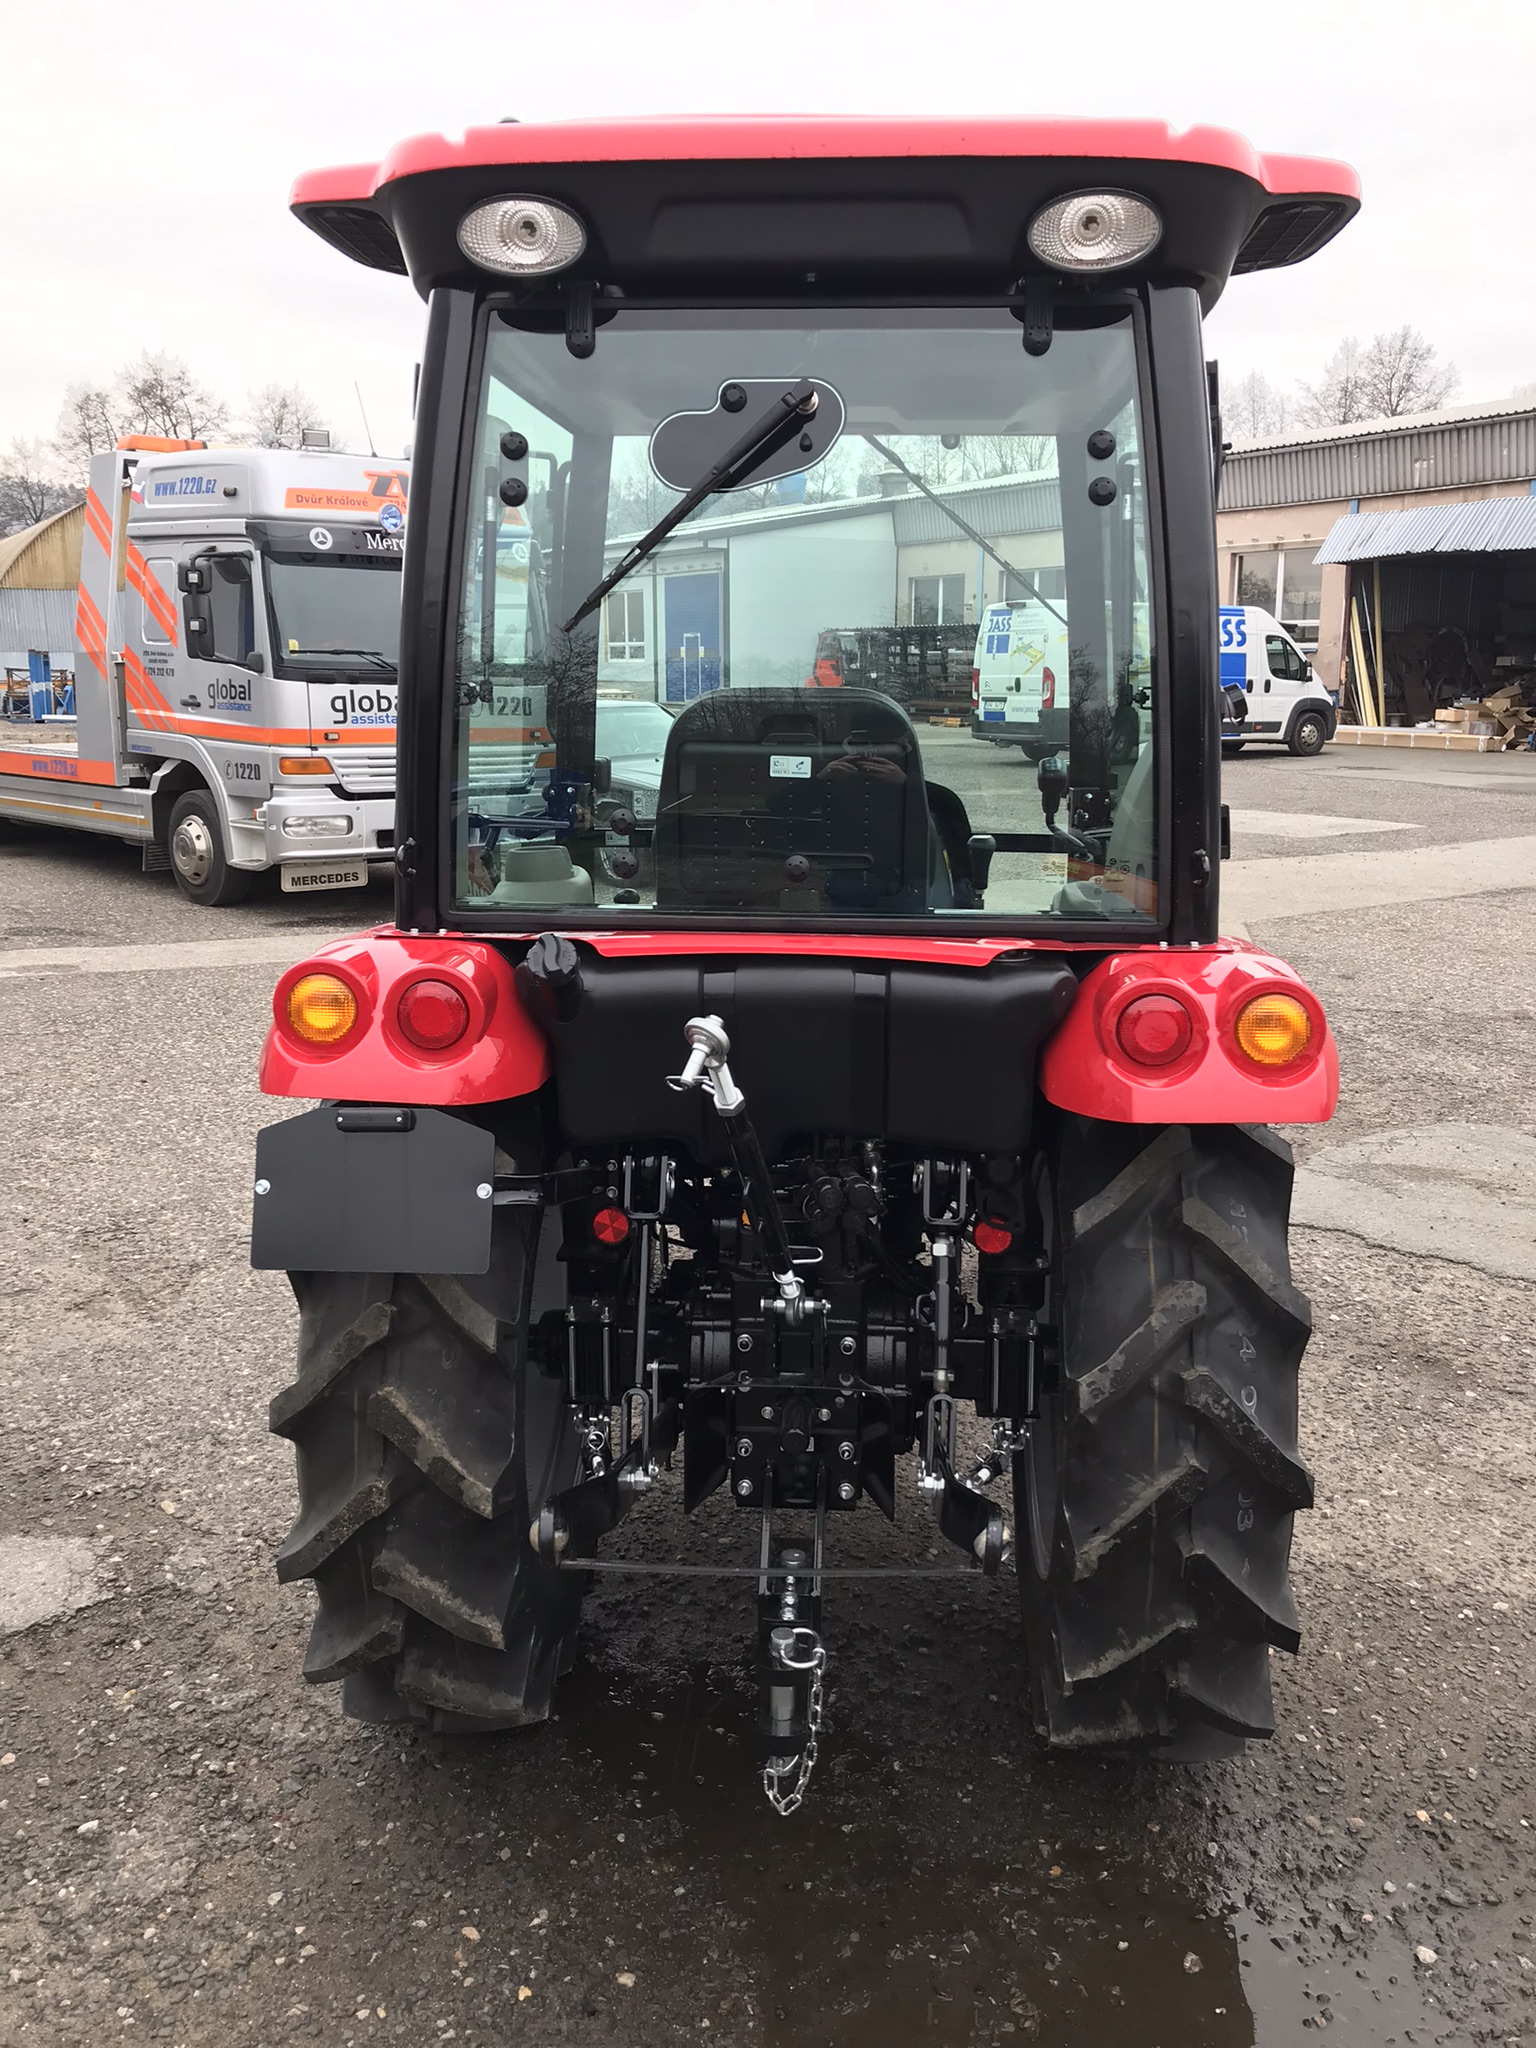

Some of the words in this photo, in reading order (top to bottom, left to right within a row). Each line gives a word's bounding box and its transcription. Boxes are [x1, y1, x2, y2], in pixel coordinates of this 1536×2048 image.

[154, 476, 217, 496] www.1220.cz
[295, 493, 322, 504] Dvůr
[326, 496, 368, 507] Králové
[987, 617, 1012, 632] JASS
[1220, 618, 1248, 647] SS
[207, 678, 252, 709] global
[216, 700, 252, 712] assistance
[330, 689, 398, 724] glob
[234, 762, 261, 781] 1220
[291, 872, 360, 887] MERCEDES
